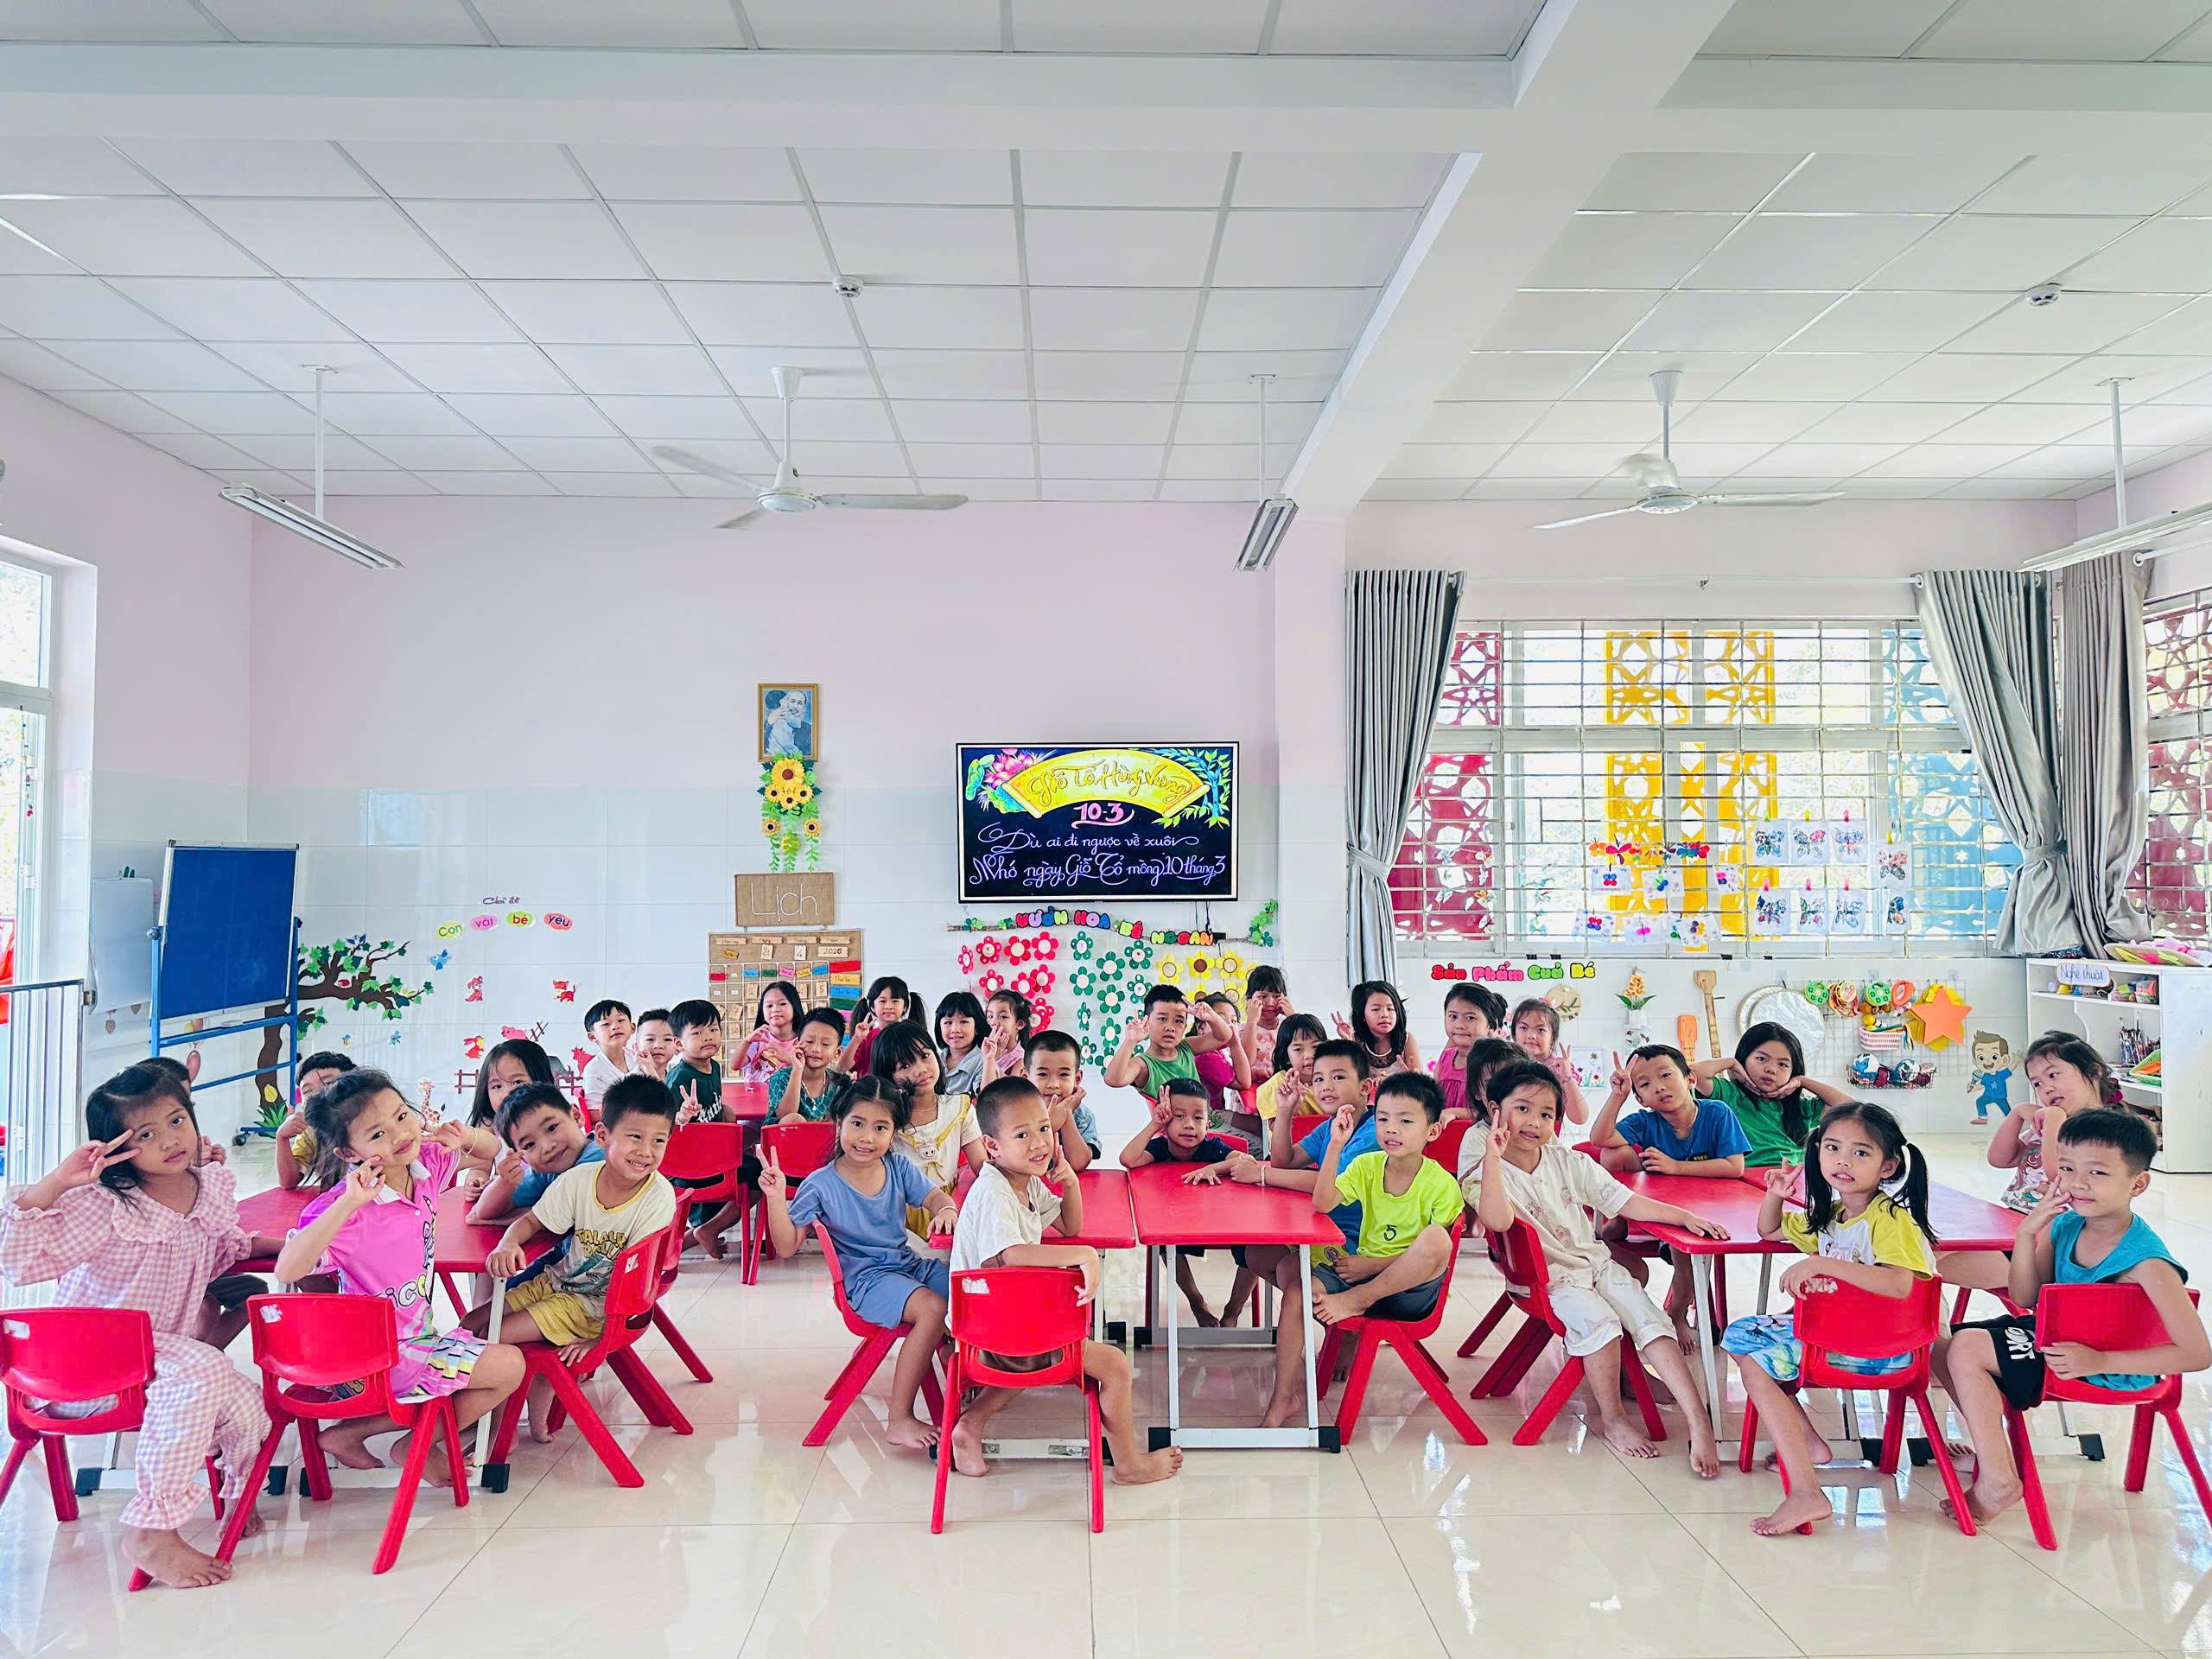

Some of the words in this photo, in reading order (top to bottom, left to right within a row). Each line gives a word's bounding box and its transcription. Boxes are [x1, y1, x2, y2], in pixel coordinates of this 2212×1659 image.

[1095, 760, 1145, 797] Hùng
[977, 821, 1042, 854] Dù
[1046, 836, 1062, 847] ai
[1064, 833, 1079, 847] đi
[1081, 836, 1122, 855] ngược
[1124, 832, 1141, 847] về
[1144, 835, 1199, 847] xuôi
[1022, 860, 1065, 888] ngày
[1065, 854, 1092, 887] Giỗ
[1095, 852, 1129, 886] Tổ
[1126, 859, 1166, 887] mồng
[1163, 855, 1184, 874] 10
[1183, 855, 1217, 887] tháng
[1214, 855, 1227, 874] 3
[438, 924, 463, 937] Con
[512, 913, 528, 925] bé
[548, 913, 570, 927] yêu
[1074, 909, 1111, 930] HOA
[1117, 920, 1144, 939] BÉ
[1149, 930, 1214, 947] NGOAN
[1569, 961, 1596, 979] Bé
[1383, 1224, 1398, 1242] 5
